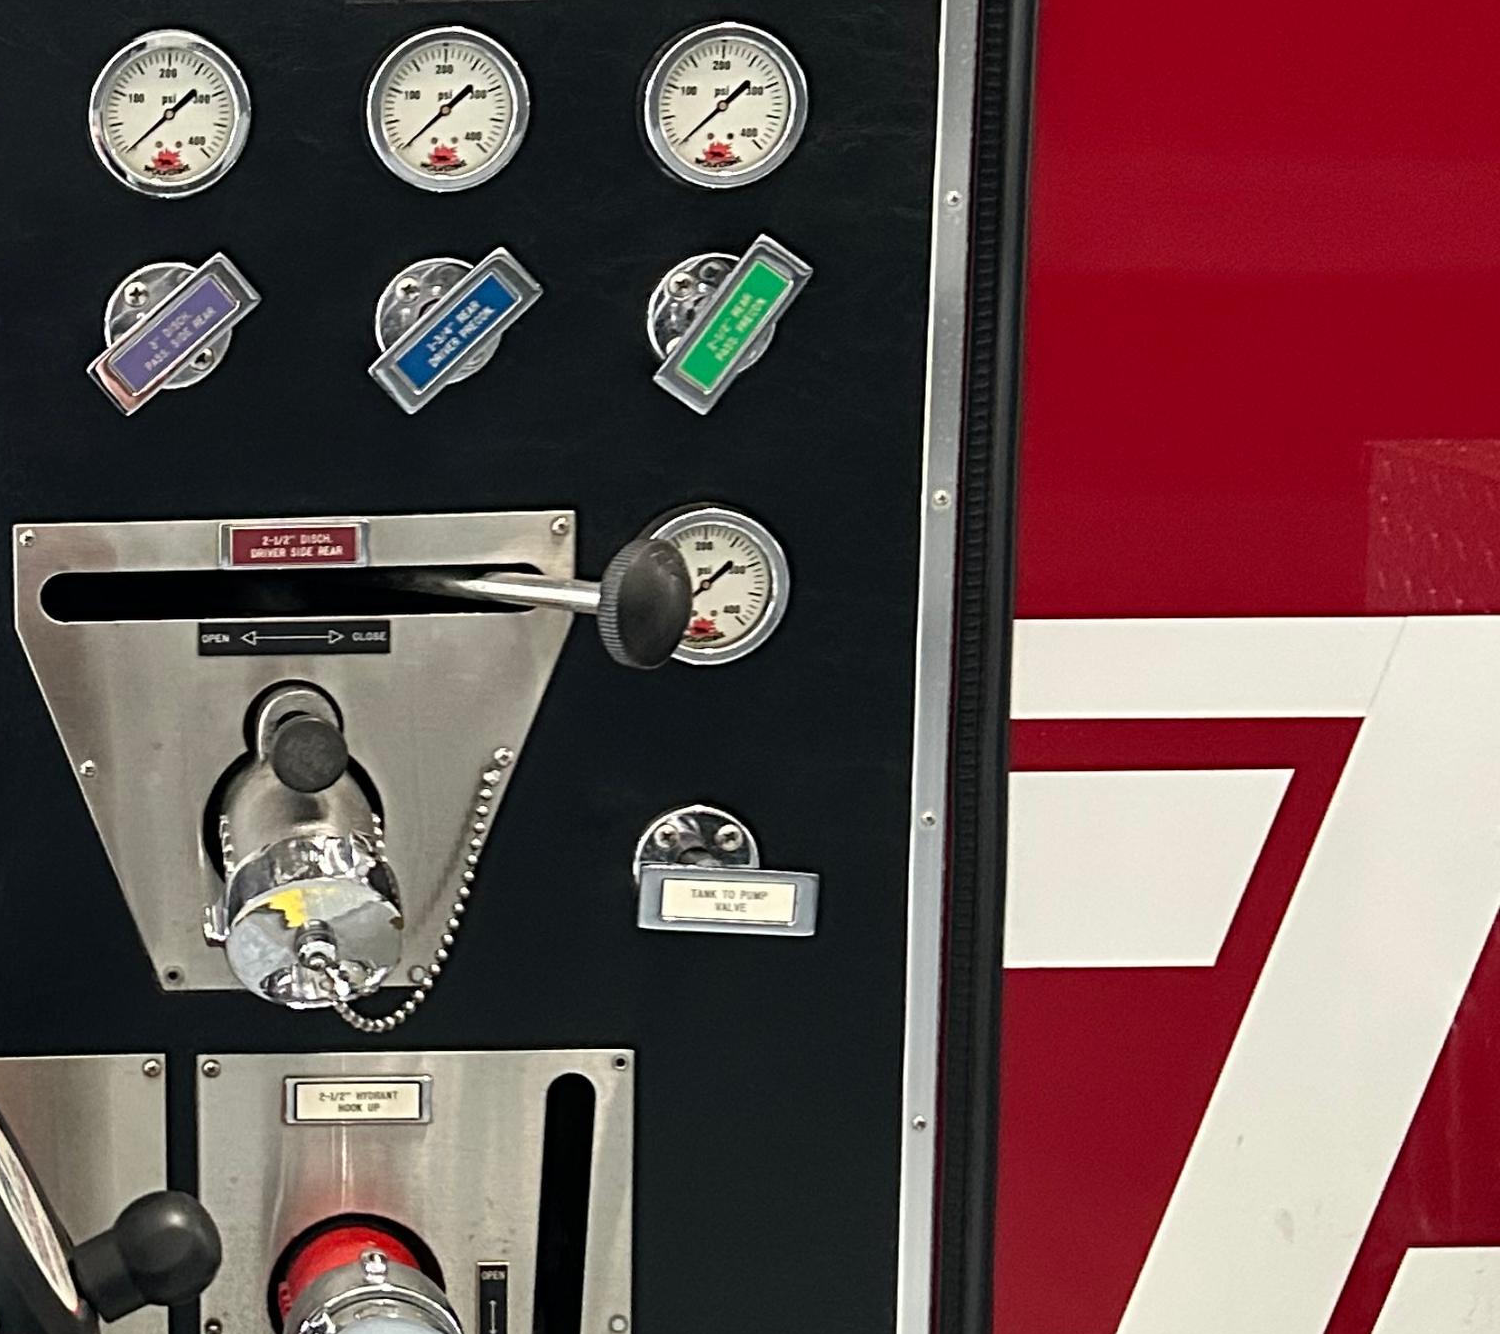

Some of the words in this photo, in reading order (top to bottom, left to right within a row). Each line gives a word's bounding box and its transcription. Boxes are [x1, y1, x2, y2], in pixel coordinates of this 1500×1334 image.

[713, 61, 730, 70] 200
[681, 86, 697, 96] 100
[715, 86, 729, 98] psi
[250, 548, 286, 559] DRIVER
[290, 547, 314, 557] SIDE
[318, 545, 343, 556] REAR
[202, 634, 230, 643] OPEN
[352, 632, 386, 641] CLOSE
[691, 889, 717, 899] TANK
[722, 890, 735, 899] TO
[740, 891, 768, 900] PUMP
[714, 902, 748, 913] VALVE
[356, 1091, 398, 1100] HYDRANT
[338, 1104, 362, 1112] HOOK
[368, 1103, 380, 1112] UP
